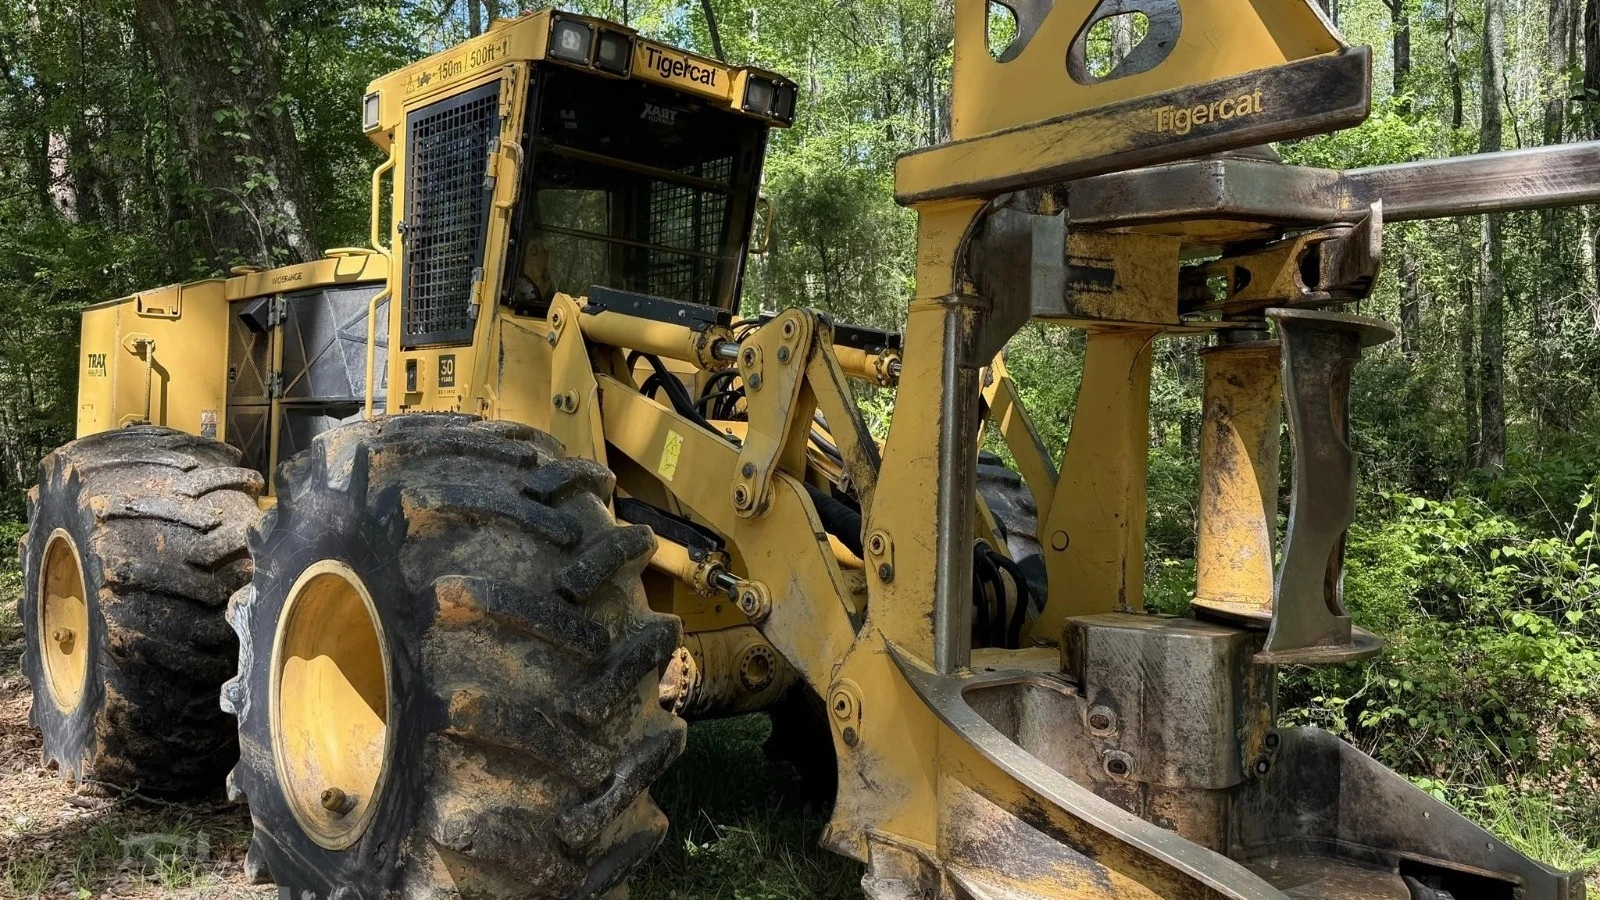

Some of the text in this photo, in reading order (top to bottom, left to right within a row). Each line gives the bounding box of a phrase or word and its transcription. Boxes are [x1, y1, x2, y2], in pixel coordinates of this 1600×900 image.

[438, 60, 462, 81] 150m
[470, 44, 495, 68] 500ft
[646, 46, 716, 87] Tigercat
[1151, 87, 1263, 135] Tigercat
[88, 353, 107, 377] TRAX
[441, 359, 453, 375] 30
